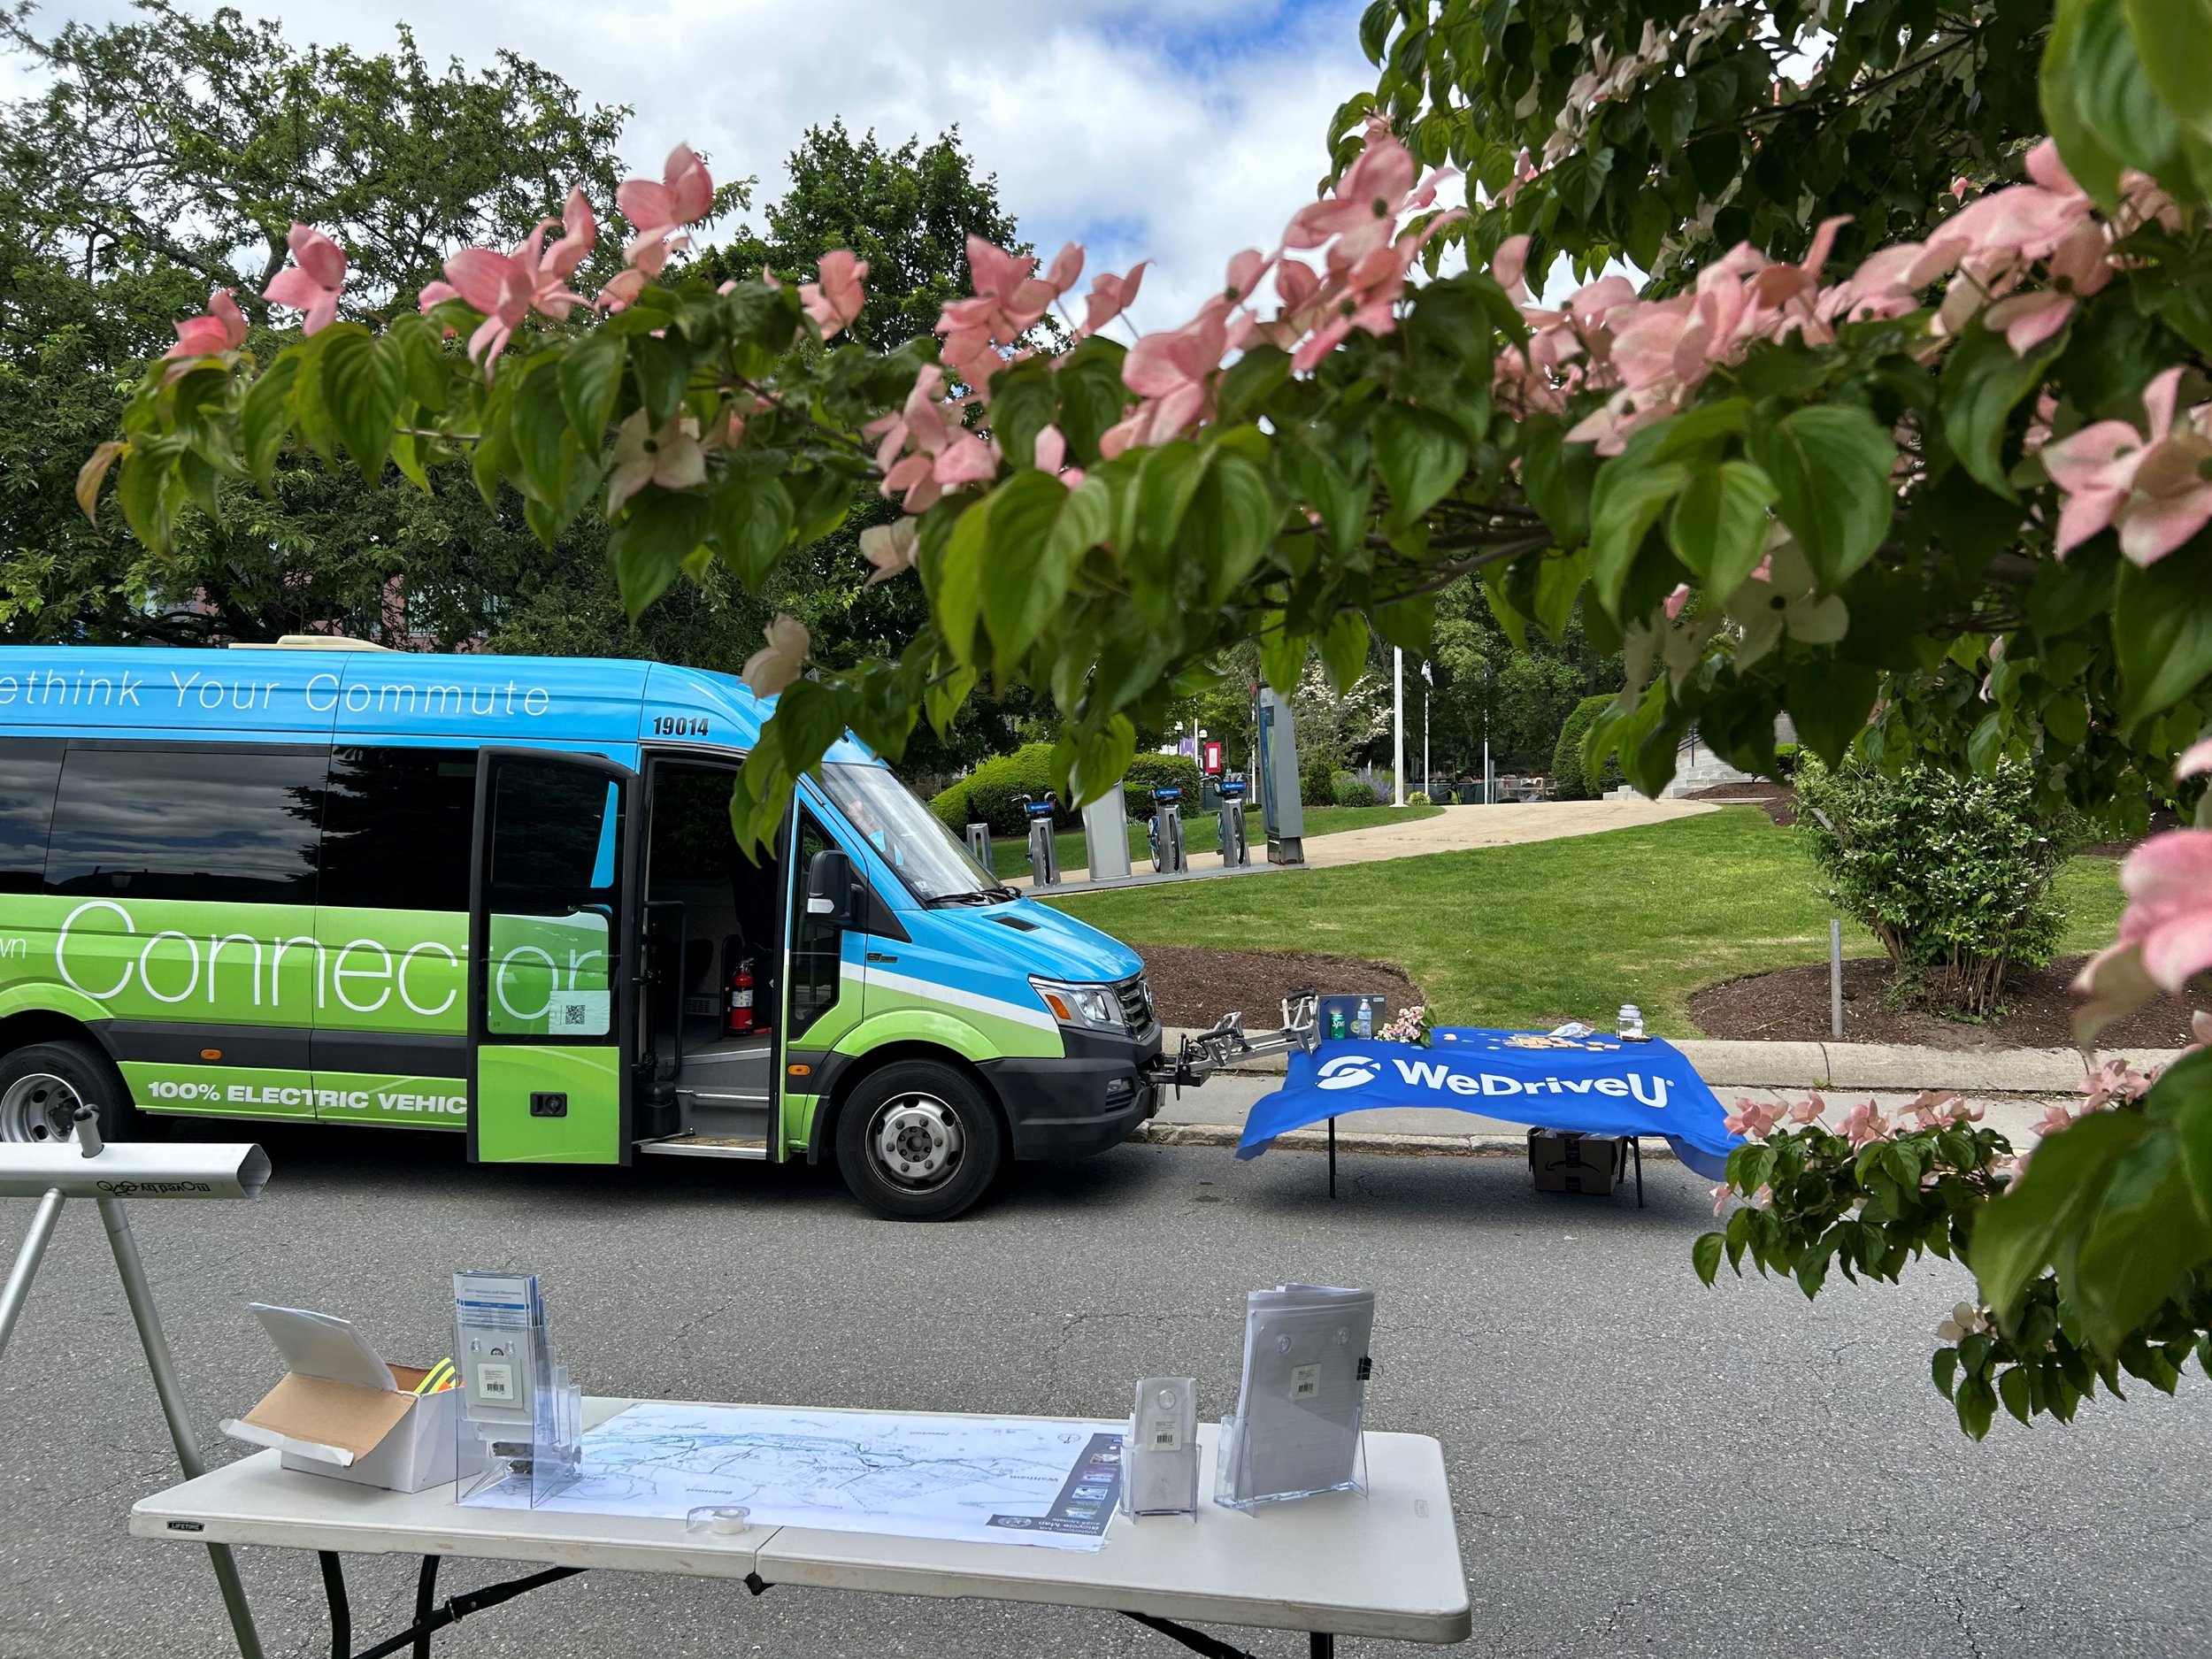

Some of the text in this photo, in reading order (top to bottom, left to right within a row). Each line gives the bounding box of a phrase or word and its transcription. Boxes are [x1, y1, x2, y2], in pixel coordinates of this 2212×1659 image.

[171, 671, 280, 712] Your
[305, 673, 551, 718] Commute
[653, 717, 709, 736] 19014
[148, 1081, 221, 1102] 100%
[227, 1085, 369, 1109] ELECTRIC
